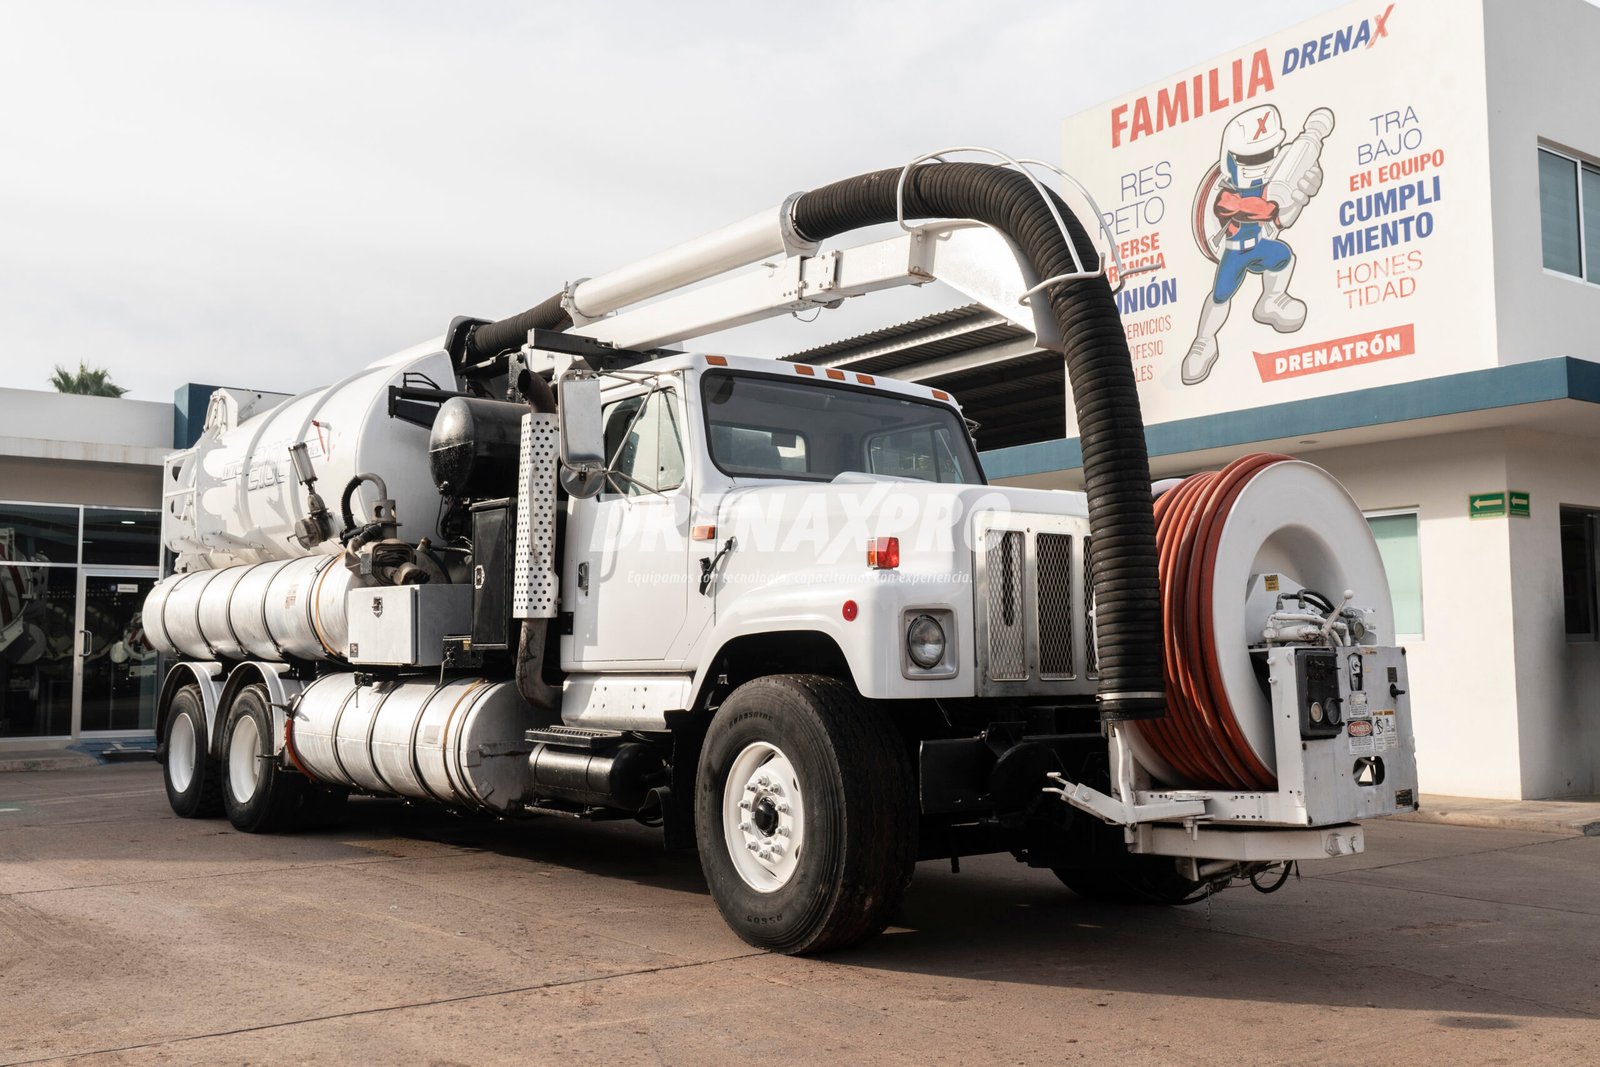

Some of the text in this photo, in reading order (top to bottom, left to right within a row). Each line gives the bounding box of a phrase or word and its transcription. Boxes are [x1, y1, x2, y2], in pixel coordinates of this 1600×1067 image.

[1111, 3, 1395, 149] FAMILIA DRENAX
[1369, 105, 1419, 136] TRA
[1357, 128, 1423, 166] BAJO
[1120, 160, 1172, 202] RES
[1349, 149, 1445, 193] EN EQUIPO
[1339, 175, 1441, 227] CUMPLI
[1332, 211, 1434, 261] MIENTO
[1337, 249, 1424, 289] HONES
[1343, 276, 1416, 309] TIDAD
[1124, 314, 1172, 340] ERVICIOS
[1274, 333, 1401, 375] DRENATRÓN
